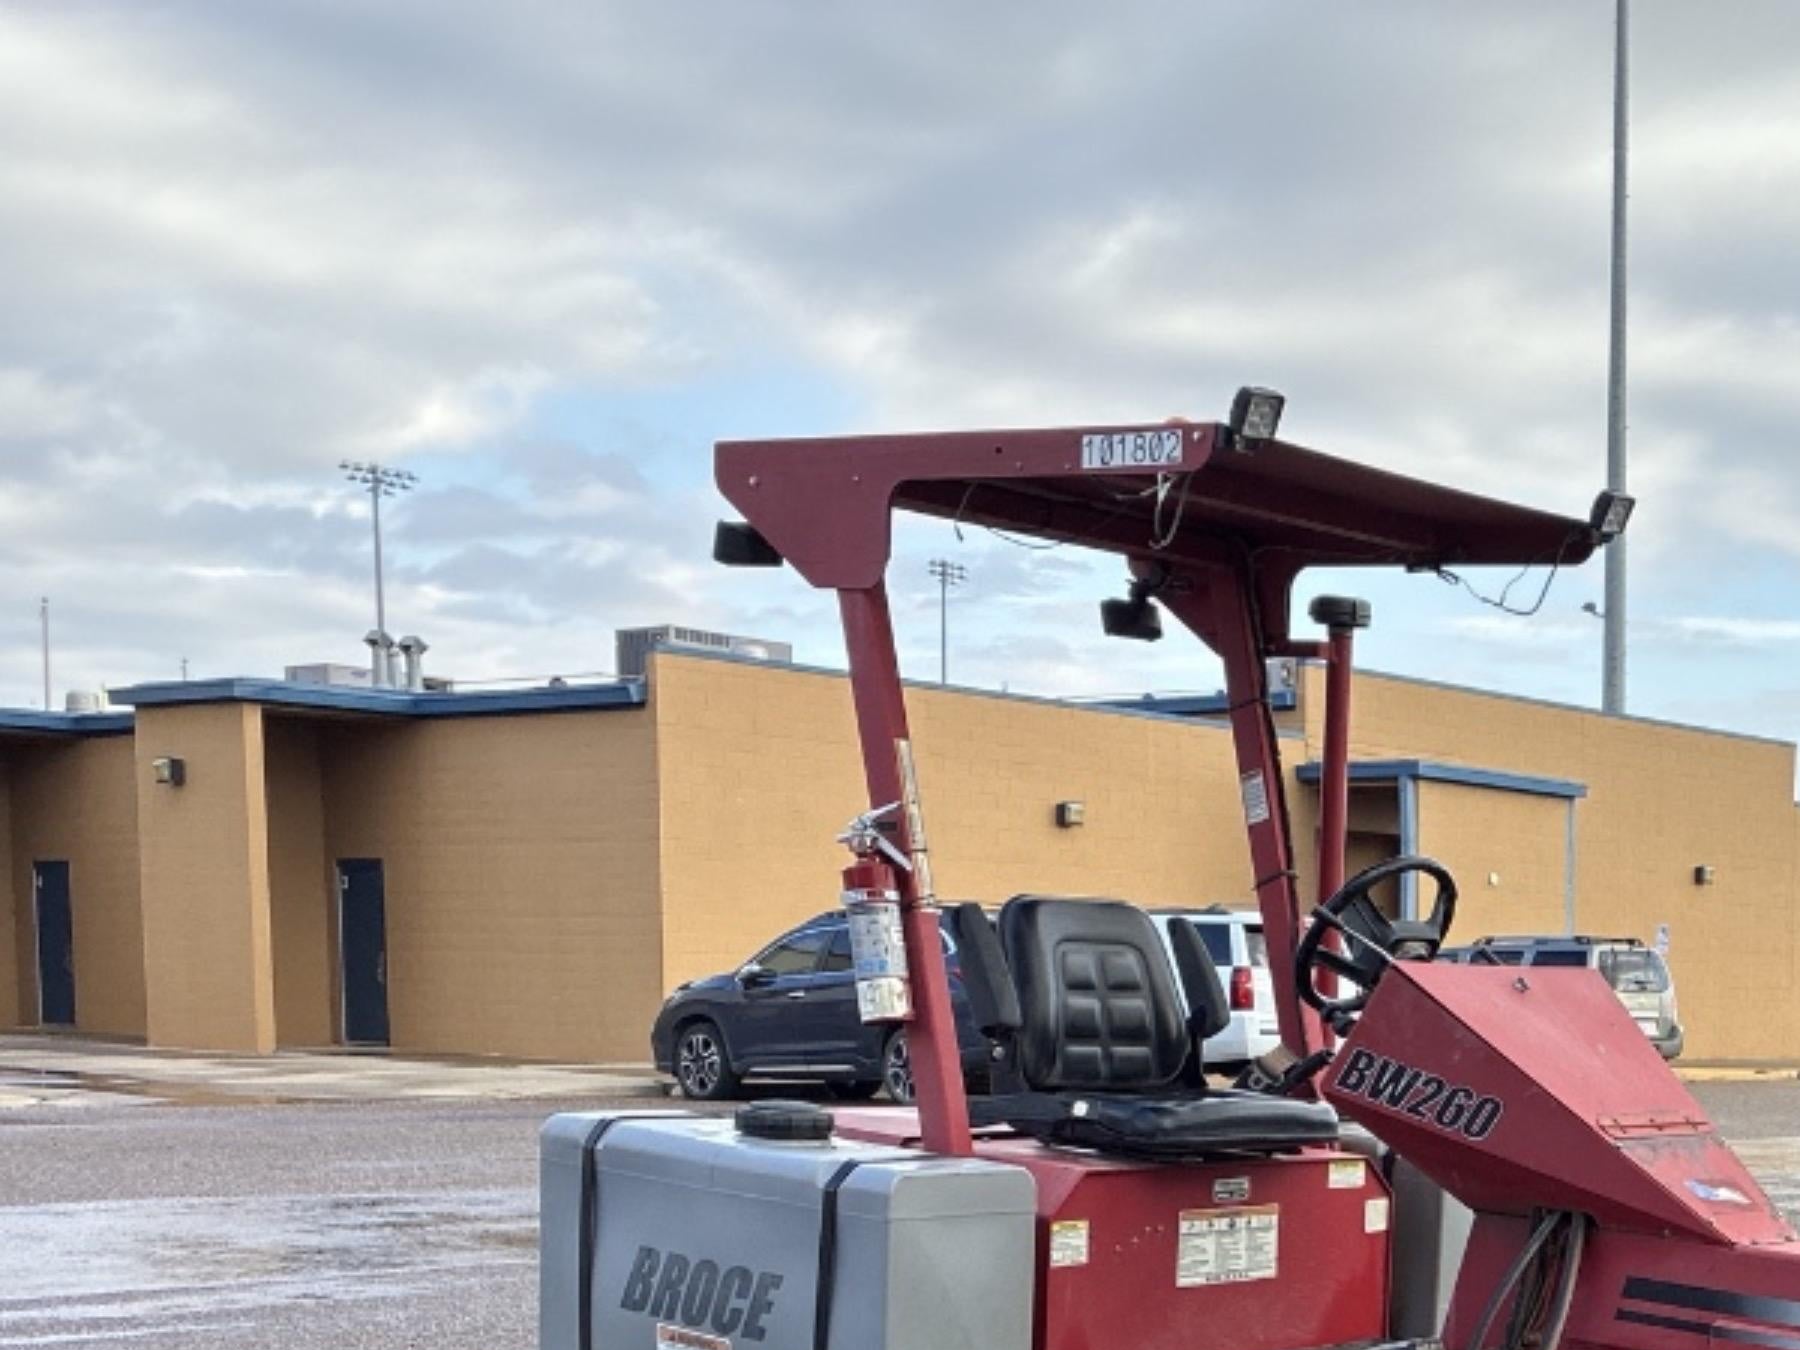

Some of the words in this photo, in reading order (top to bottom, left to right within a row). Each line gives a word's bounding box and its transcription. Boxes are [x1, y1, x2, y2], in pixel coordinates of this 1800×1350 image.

[1084, 430, 1180, 467] 101802
[1334, 1047, 1504, 1141] BW260
[620, 1244, 784, 1342] BROCE
